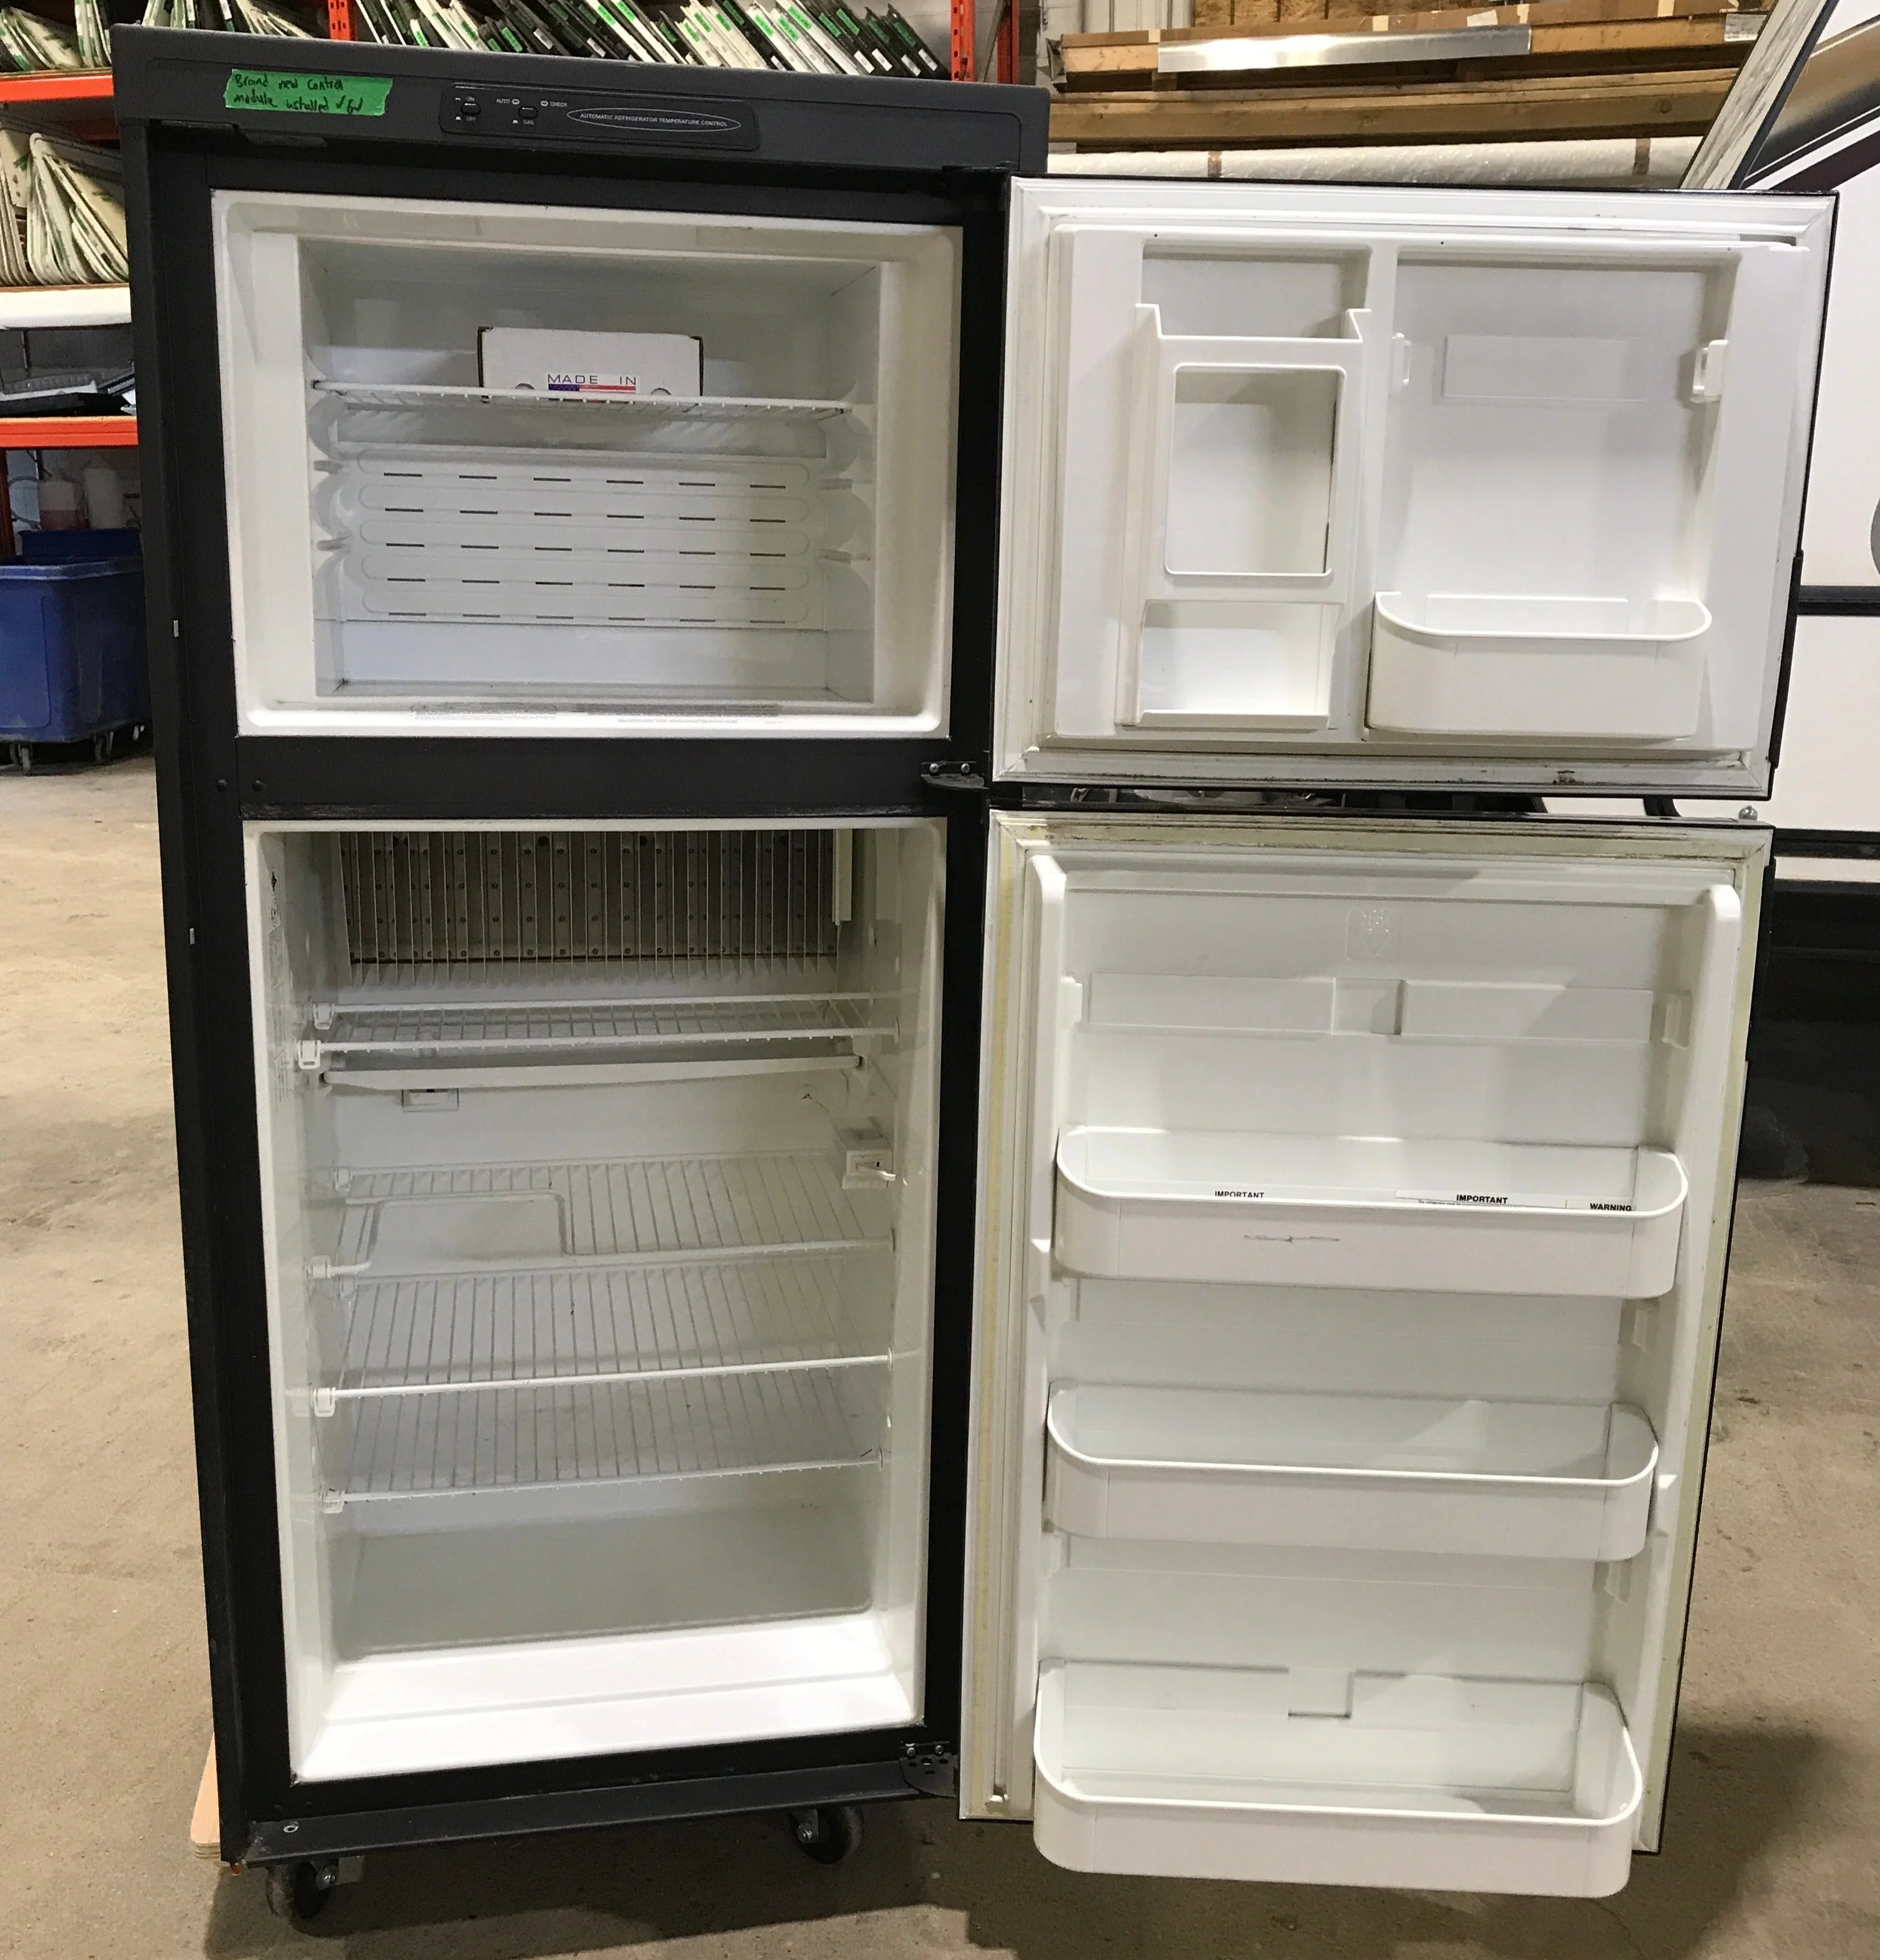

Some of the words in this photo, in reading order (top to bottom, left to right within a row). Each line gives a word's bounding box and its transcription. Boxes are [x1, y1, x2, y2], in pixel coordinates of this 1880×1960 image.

[234, 73, 268, 88] Brand
[547, 374, 598, 384] MADE
[619, 375, 637, 385] IN
[1215, 1190, 1265, 1199] IMPORTANT
[1456, 1194, 1508, 1204] IMPORTANT
[1590, 1202, 1632, 1212] WARNING
